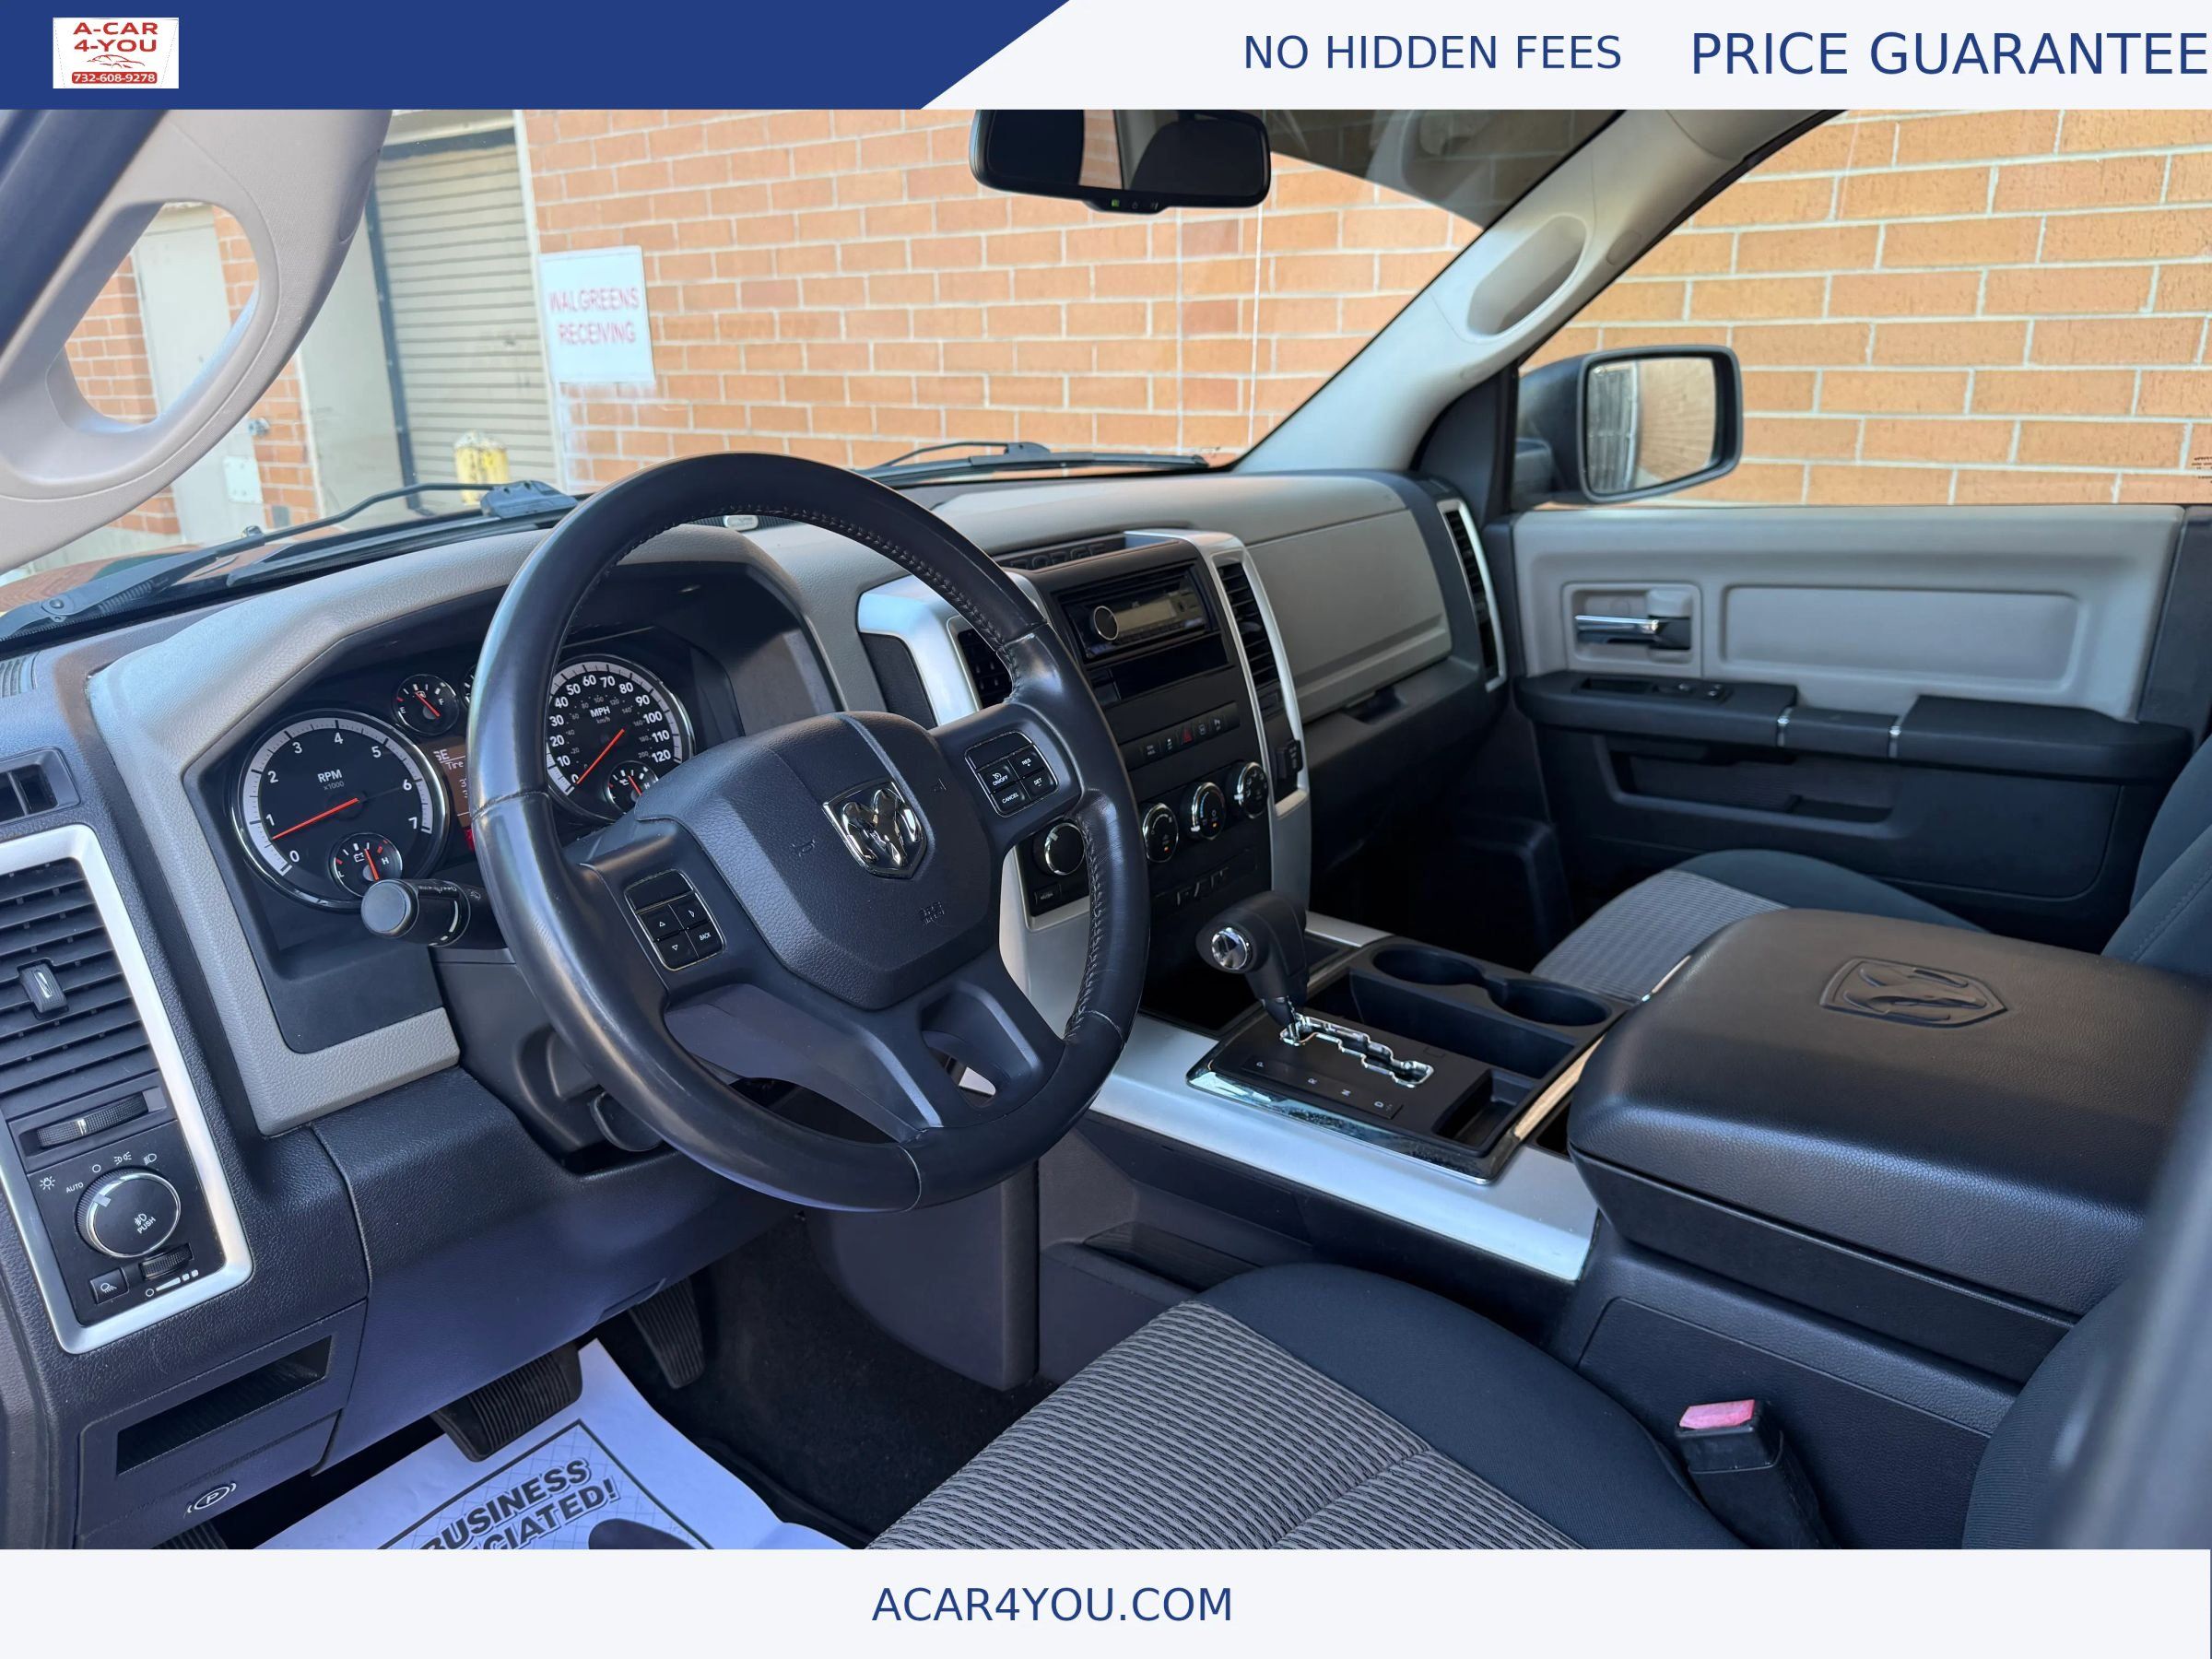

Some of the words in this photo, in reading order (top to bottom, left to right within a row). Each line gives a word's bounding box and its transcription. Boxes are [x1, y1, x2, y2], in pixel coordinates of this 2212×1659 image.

[550, 287, 640, 312] WALGREENS
[559, 321, 636, 345] RECEIVING
[582, 675, 596, 687] 60
[600, 676, 616, 688] 70
[566, 683, 581, 695] 50
[618, 682, 634, 694] 80
[555, 696, 569, 708] 40
[635, 694, 650, 707] 90
[590, 706, 610, 718] MPH
[643, 711, 663, 724] 100
[549, 714, 564, 726] 30
[334, 732, 343, 744] 4
[549, 735, 564, 747] 20
[652, 730, 670, 743] 110
[293, 742, 302, 753] 3
[371, 746, 382, 758] 5
[557, 755, 571, 767] 10
[652, 749, 671, 763] 120
[446, 760, 464, 771] Tire
[267, 771, 278, 782] 2
[317, 769, 342, 783] RPM
[324, 781, 345, 790] x1000
[403, 779, 412, 791] 6
[1002, 793, 1018, 804] CANCEL
[265, 814, 275, 826] 1
[408, 817, 418, 829] 7
[289, 851, 300, 862] 0
[700, 932, 712, 941] BACK
[65, 1182, 84, 1193] AUTO
[136, 1217, 157, 1234] PUSH
